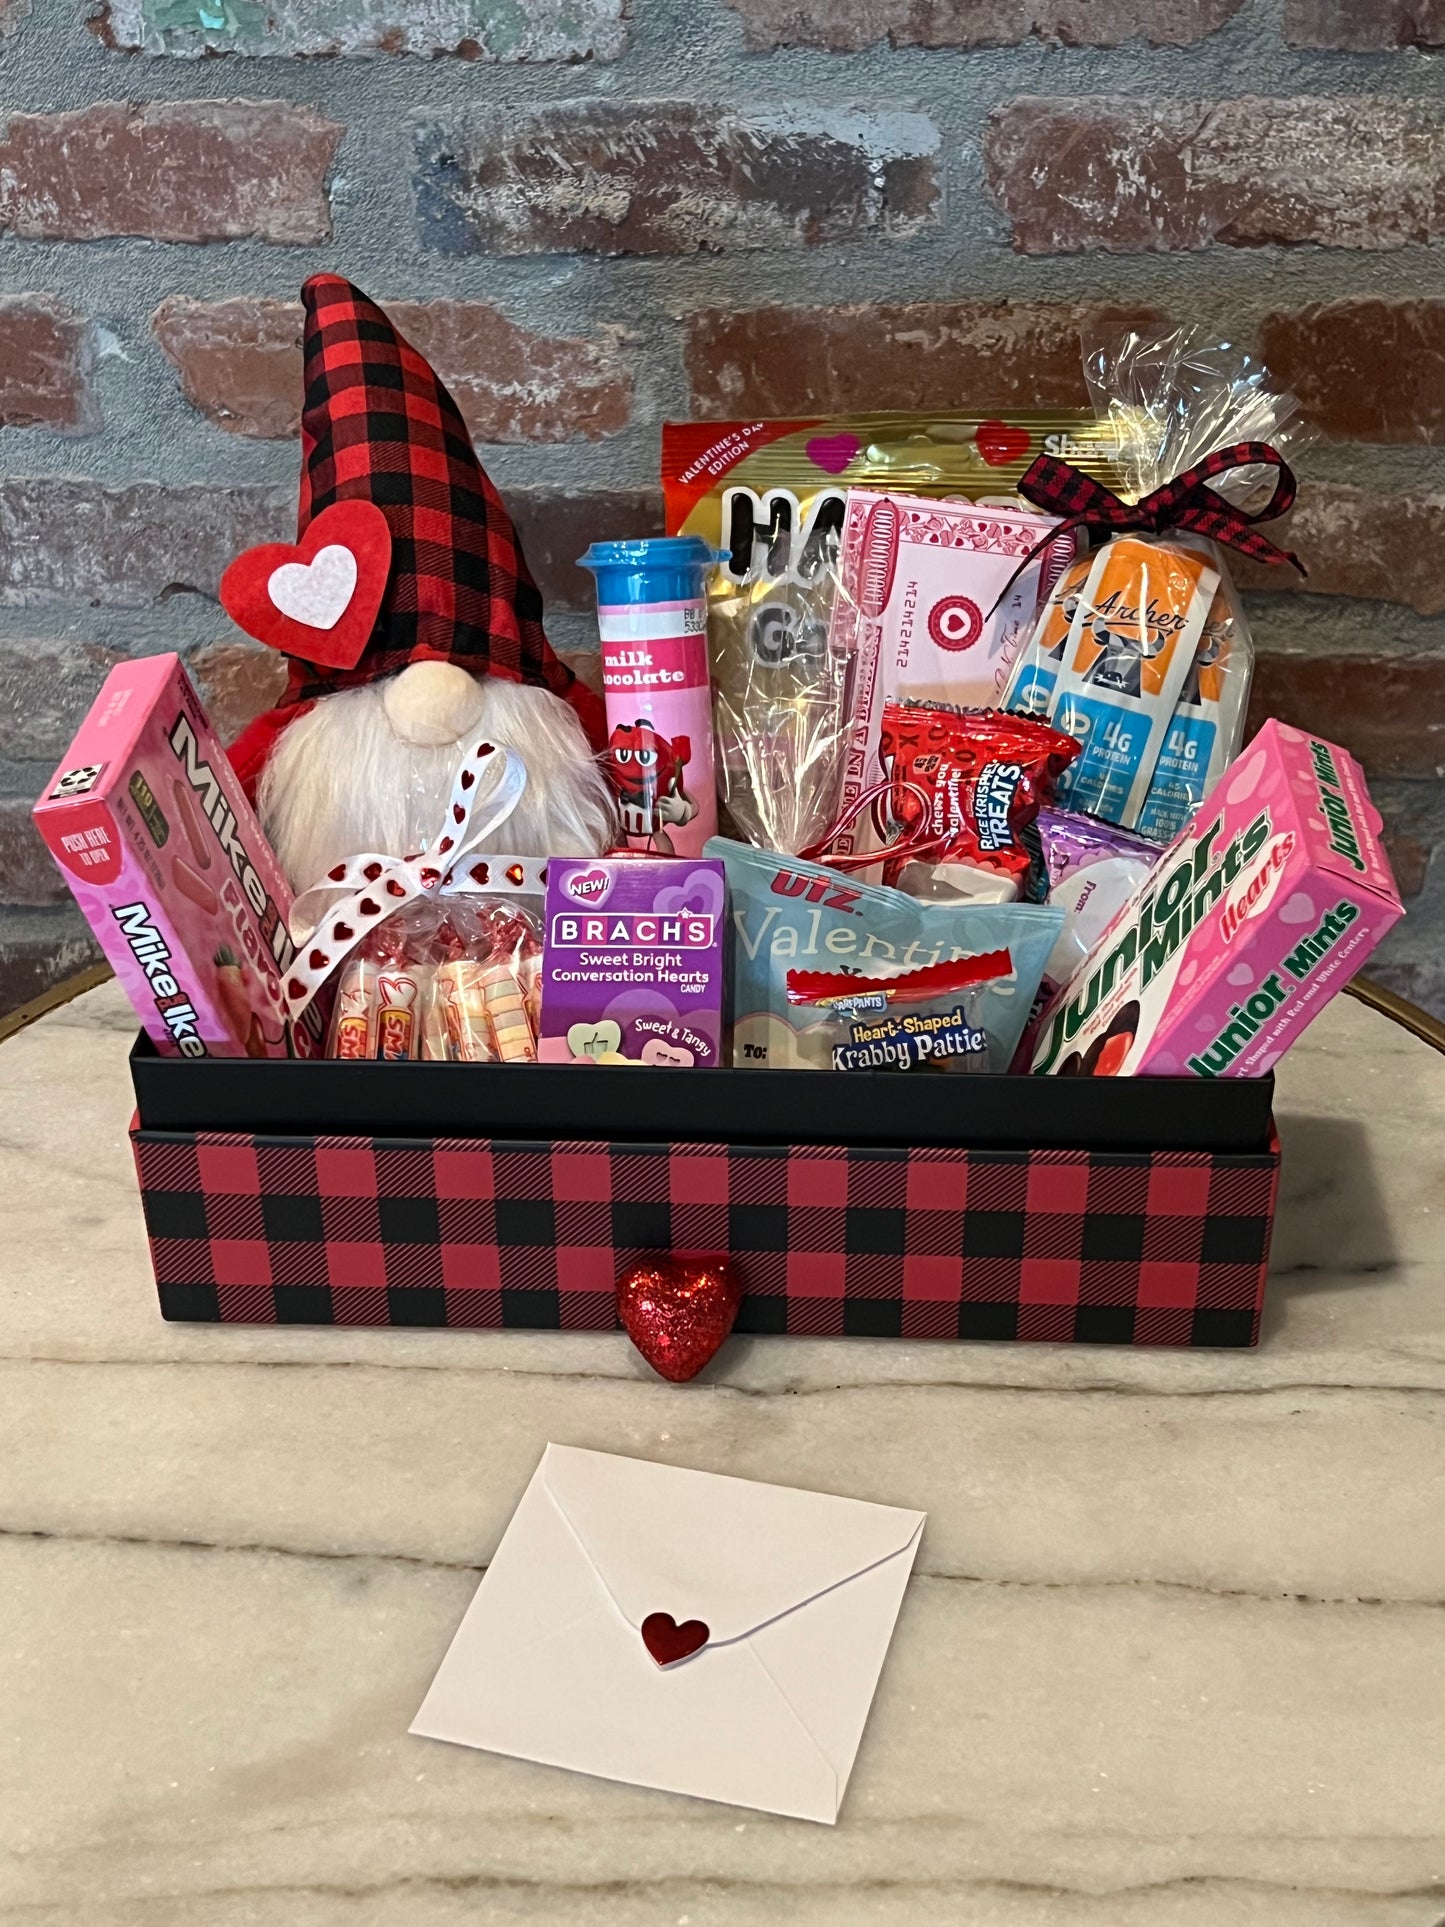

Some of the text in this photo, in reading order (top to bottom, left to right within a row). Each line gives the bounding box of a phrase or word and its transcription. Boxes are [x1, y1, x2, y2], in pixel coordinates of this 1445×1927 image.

[678, 422, 763, 483] VALENTINE'S DAY
[708, 441, 749, 475] EDITION
[896, 581, 918, 667] 214214214
[1084, 591, 1189, 630] Archer
[605, 651, 653, 666] milk
[604, 670, 684, 685] ocolate
[854, 726, 868, 746] A
[1103, 721, 1133, 753] 4G
[1168, 730, 1199, 760] 4G
[848, 750, 866, 779] IN
[1092, 746, 1132, 766] PROTEIN
[1160, 756, 1199, 773] PROTEIN
[989, 765, 1022, 848] TREATS
[1151, 787, 1191, 801] CALORIE
[1310, 740, 1367, 873] Junior Mints
[168, 709, 266, 916] Mike
[932, 793, 944, 835] chews
[61, 827, 111, 853] PUSH HERE
[975, 814, 994, 850] RICE
[570, 878, 609, 896] NEW!
[1139, 804, 1273, 995] Mints
[1220, 831, 1295, 943] Hearts
[1032, 808, 1225, 1075] Junior
[1279, 898, 1361, 983] Mints
[552, 969, 709, 983] Conversation Hearts
[580, 952, 682, 969] Sweet Bright
[113, 902, 180, 997] Mike
[163, 1003, 207, 1058] Ike
[681, 984, 706, 993] CANDY
[1245, 1036, 1275, 1067] Shaped
[1274, 1018, 1291, 1036] with
[1287, 1001, 1304, 1017] Red
[1303, 983, 1320, 1001] and
[1316, 960, 1341, 983] White
[1338, 927, 1370, 959] Centers
[635, 1019, 711, 1056] Sweet & Tangy
[853, 1010, 962, 1042] Heart-Shaped
[832, 1041, 911, 1070] Krabby
